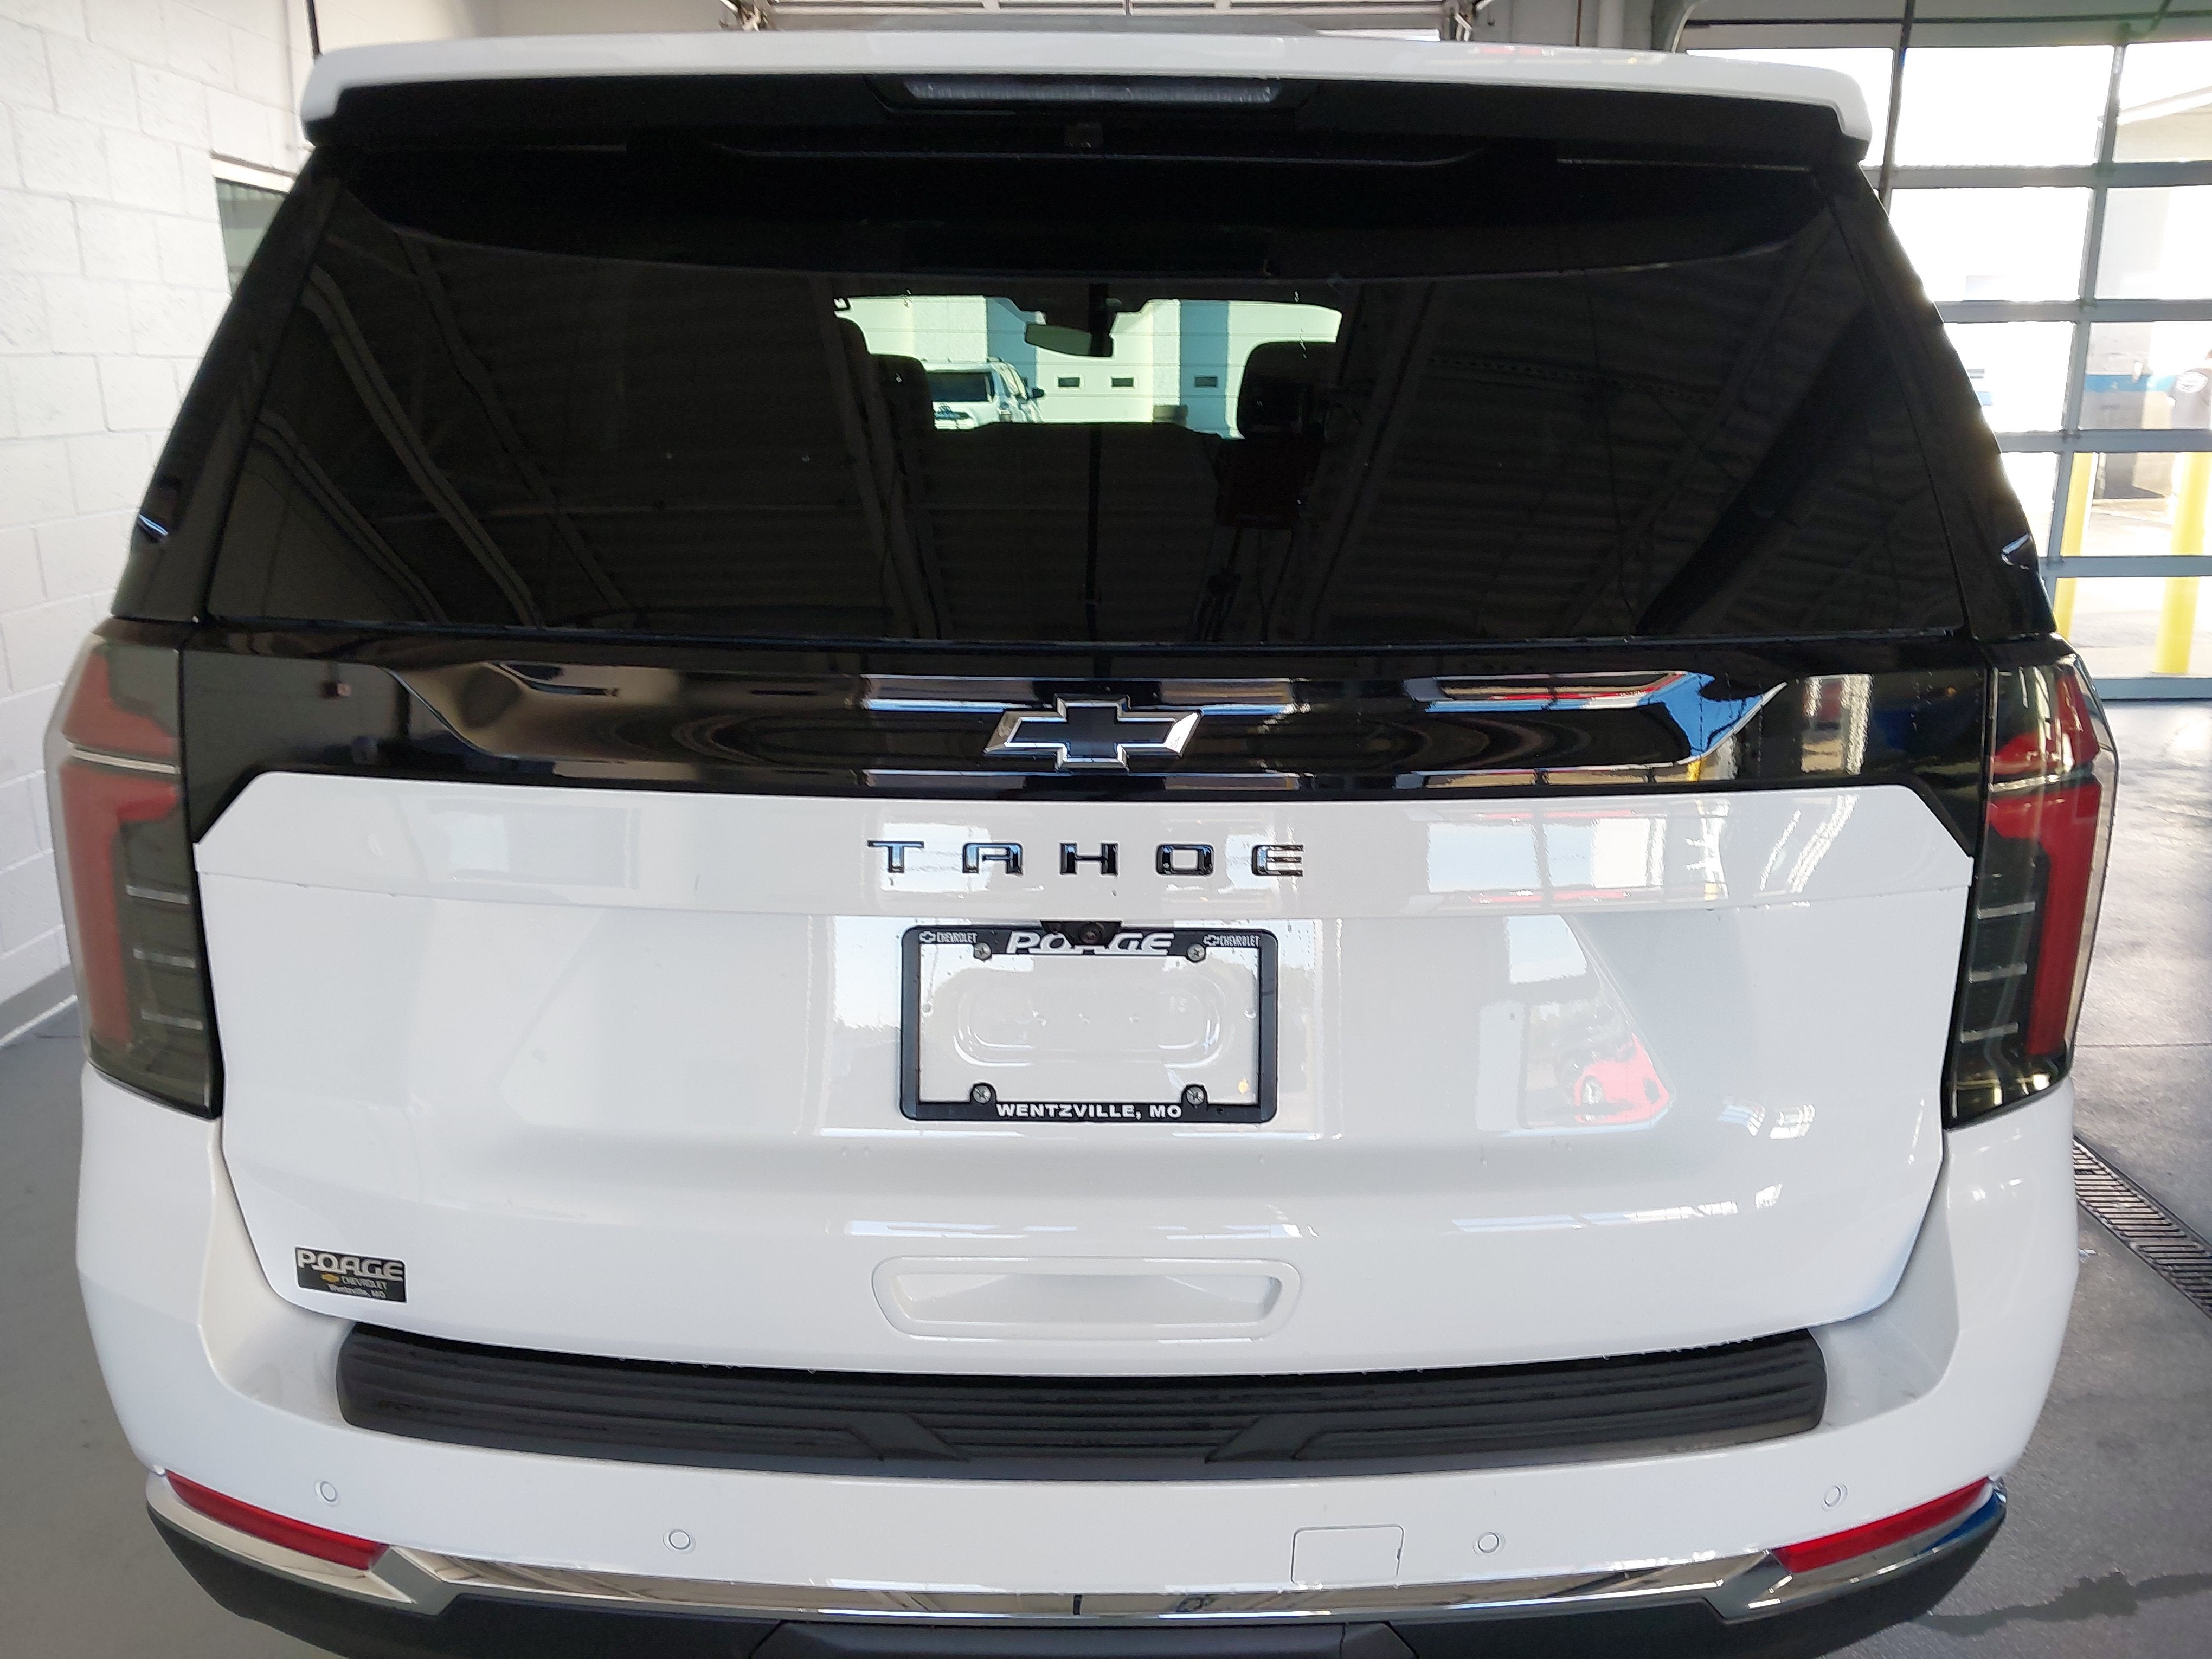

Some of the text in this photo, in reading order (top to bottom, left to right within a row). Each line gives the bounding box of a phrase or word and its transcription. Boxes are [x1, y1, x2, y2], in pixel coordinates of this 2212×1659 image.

[867, 840, 1304, 876] TAHOE
[1006, 931, 1175, 955] POGE
[995, 1103, 1182, 1121] WENTZVILLE, MO
[298, 1249, 403, 1282] POAGE
